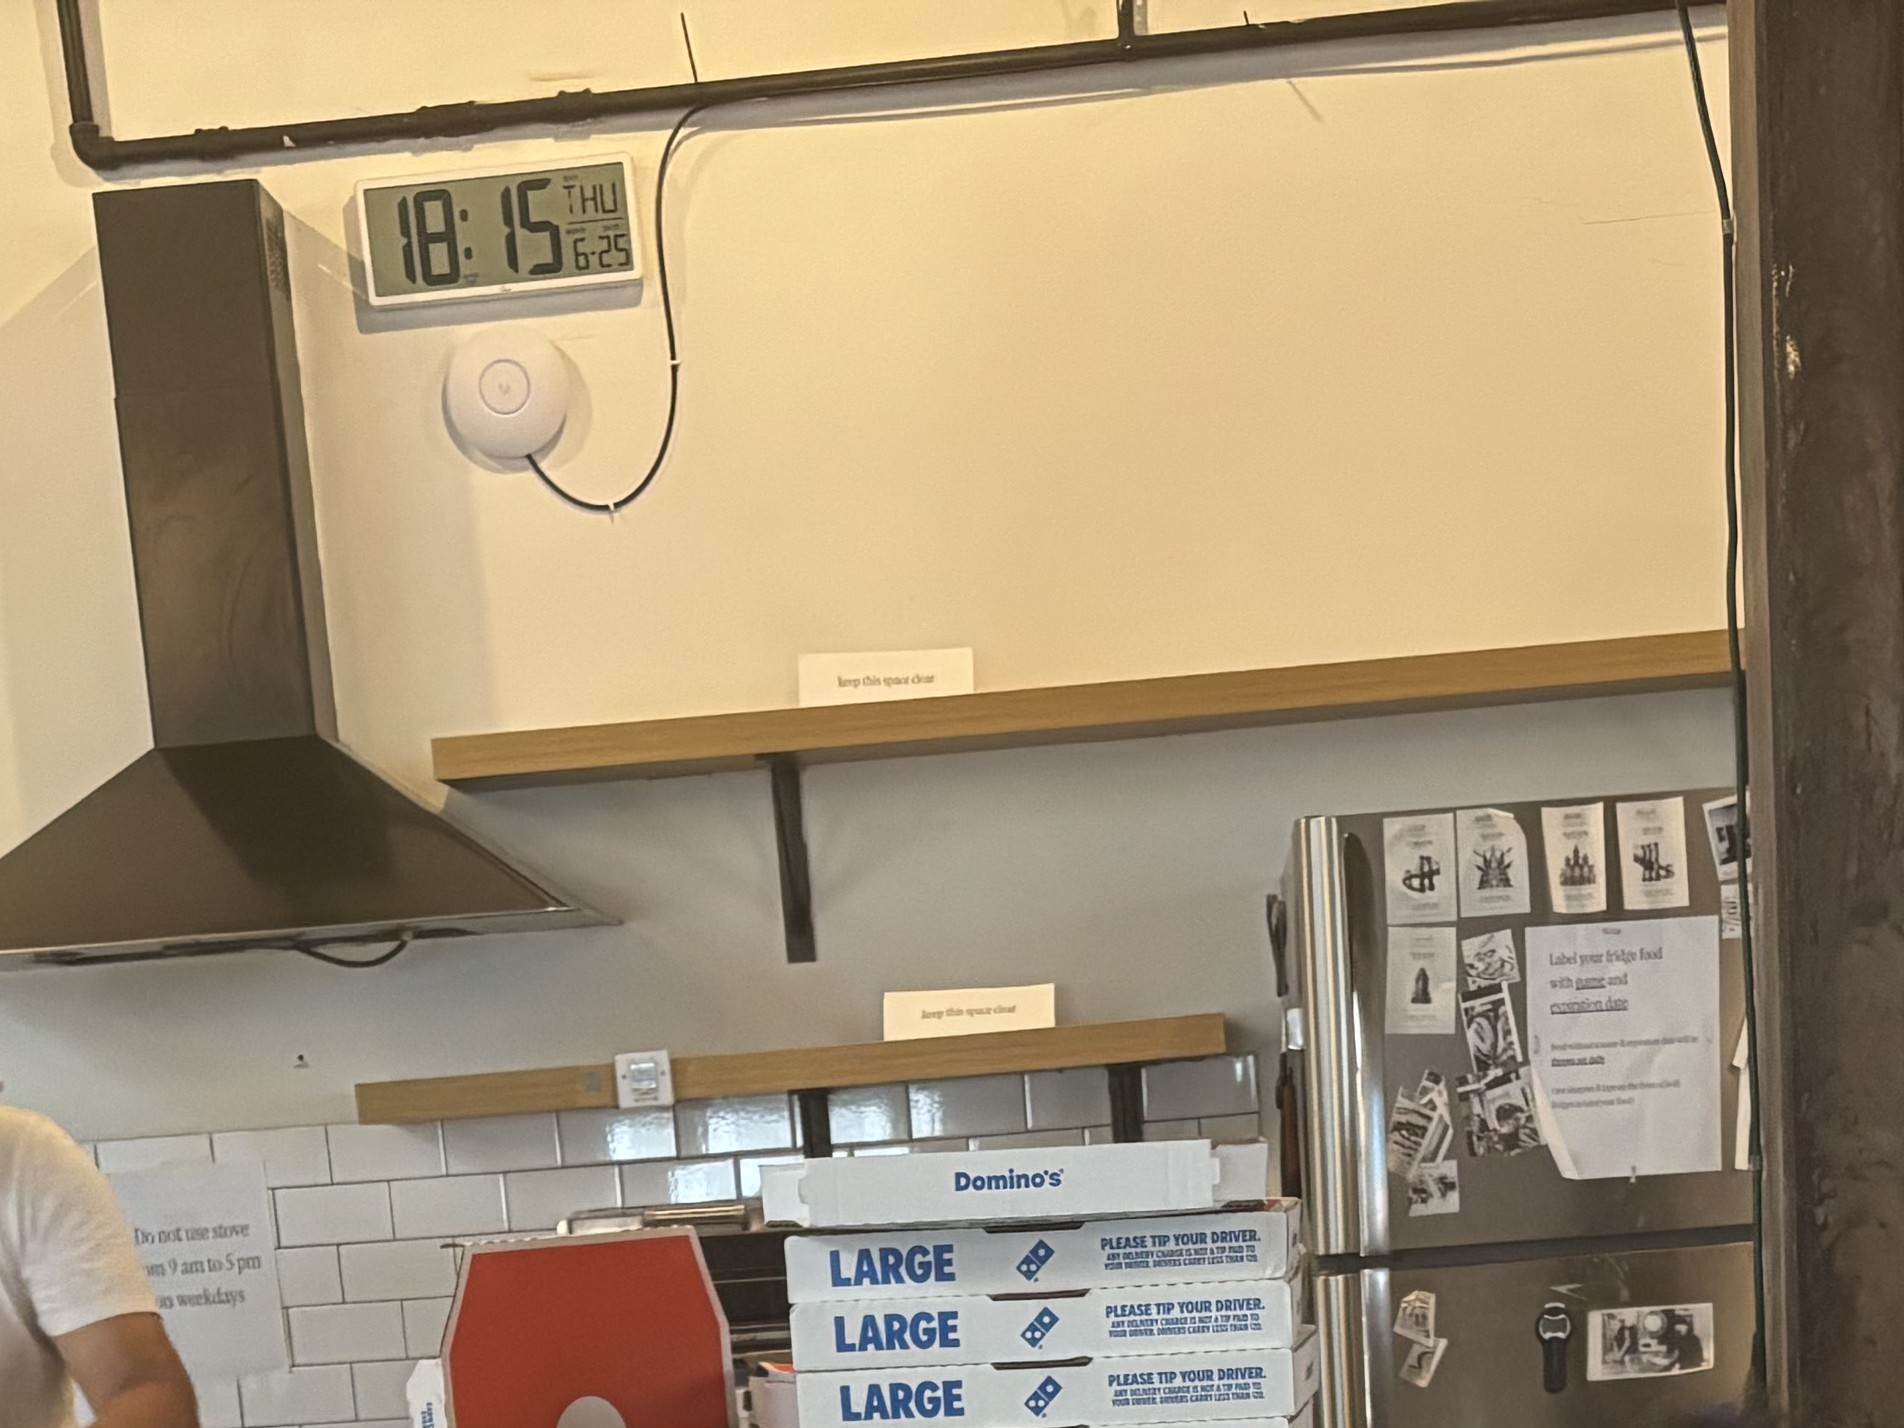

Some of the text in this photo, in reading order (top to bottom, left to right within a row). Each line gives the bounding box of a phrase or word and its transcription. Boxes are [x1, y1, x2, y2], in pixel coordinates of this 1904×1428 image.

[562, 182, 618, 215] THU
[398, 178, 563, 286] 18:15
[573, 233, 630, 271] 6-25
[862, 675, 881, 686] this
[1549, 946, 1663, 967] Label your fridge food
[1549, 976, 1573, 989] with
[1607, 973, 1628, 986] and
[955, 1168, 1064, 1191] Domino's
[158, 1226, 183, 1243] not
[186, 1227, 209, 1241] use
[211, 1223, 250, 1240] stove
[1101, 1235, 1147, 1250] PLEASE
[1151, 1234, 1170, 1248] TIP
[1174, 1232, 1207, 1246] YOUR
[168, 1258, 178, 1275] 9
[181, 1260, 206, 1275] am
[208, 1258, 222, 1273] to
[225, 1254, 235, 1272] 5
[237, 1254, 261, 1275] pm
[829, 1246, 954, 1288] LARGE
[176, 1287, 246, 1308] weekdays
[1106, 1303, 1152, 1318] PLEASE
[1156, 1302, 1174, 1315] TIP
[1178, 1300, 1212, 1314] YOUR
[834, 1311, 961, 1353] LARGE
[1108, 1372, 1154, 1387] PLEASE
[1158, 1371, 1176, 1384] TIP
[1180, 1369, 1214, 1383] YOUR
[839, 1380, 965, 1422] LARGE
